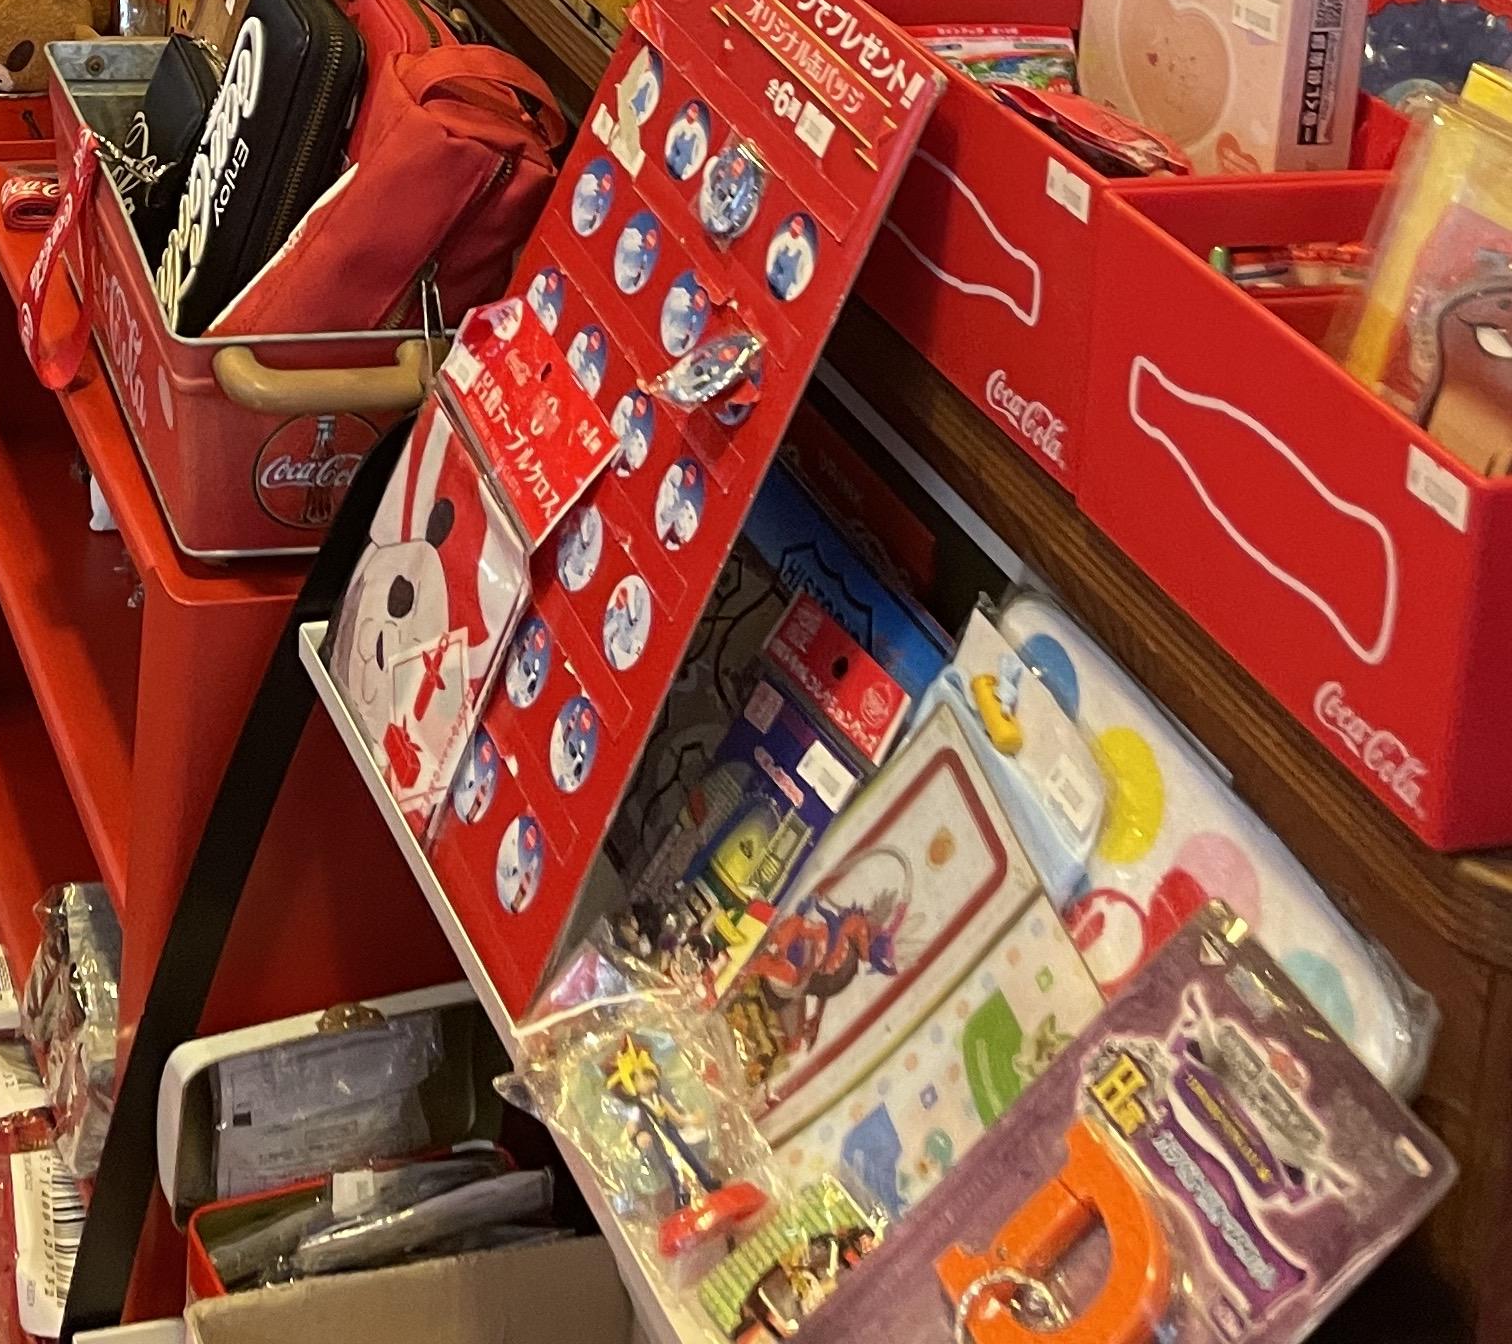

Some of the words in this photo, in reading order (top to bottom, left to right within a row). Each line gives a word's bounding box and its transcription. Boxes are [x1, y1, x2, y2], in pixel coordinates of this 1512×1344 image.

[0, 178, 61, 203] Coca-C
[213, 138, 250, 227] Enjoy
[984, 366, 1069, 470] Coca-Cola
[1312, 678, 1432, 816] Coca-Cola
